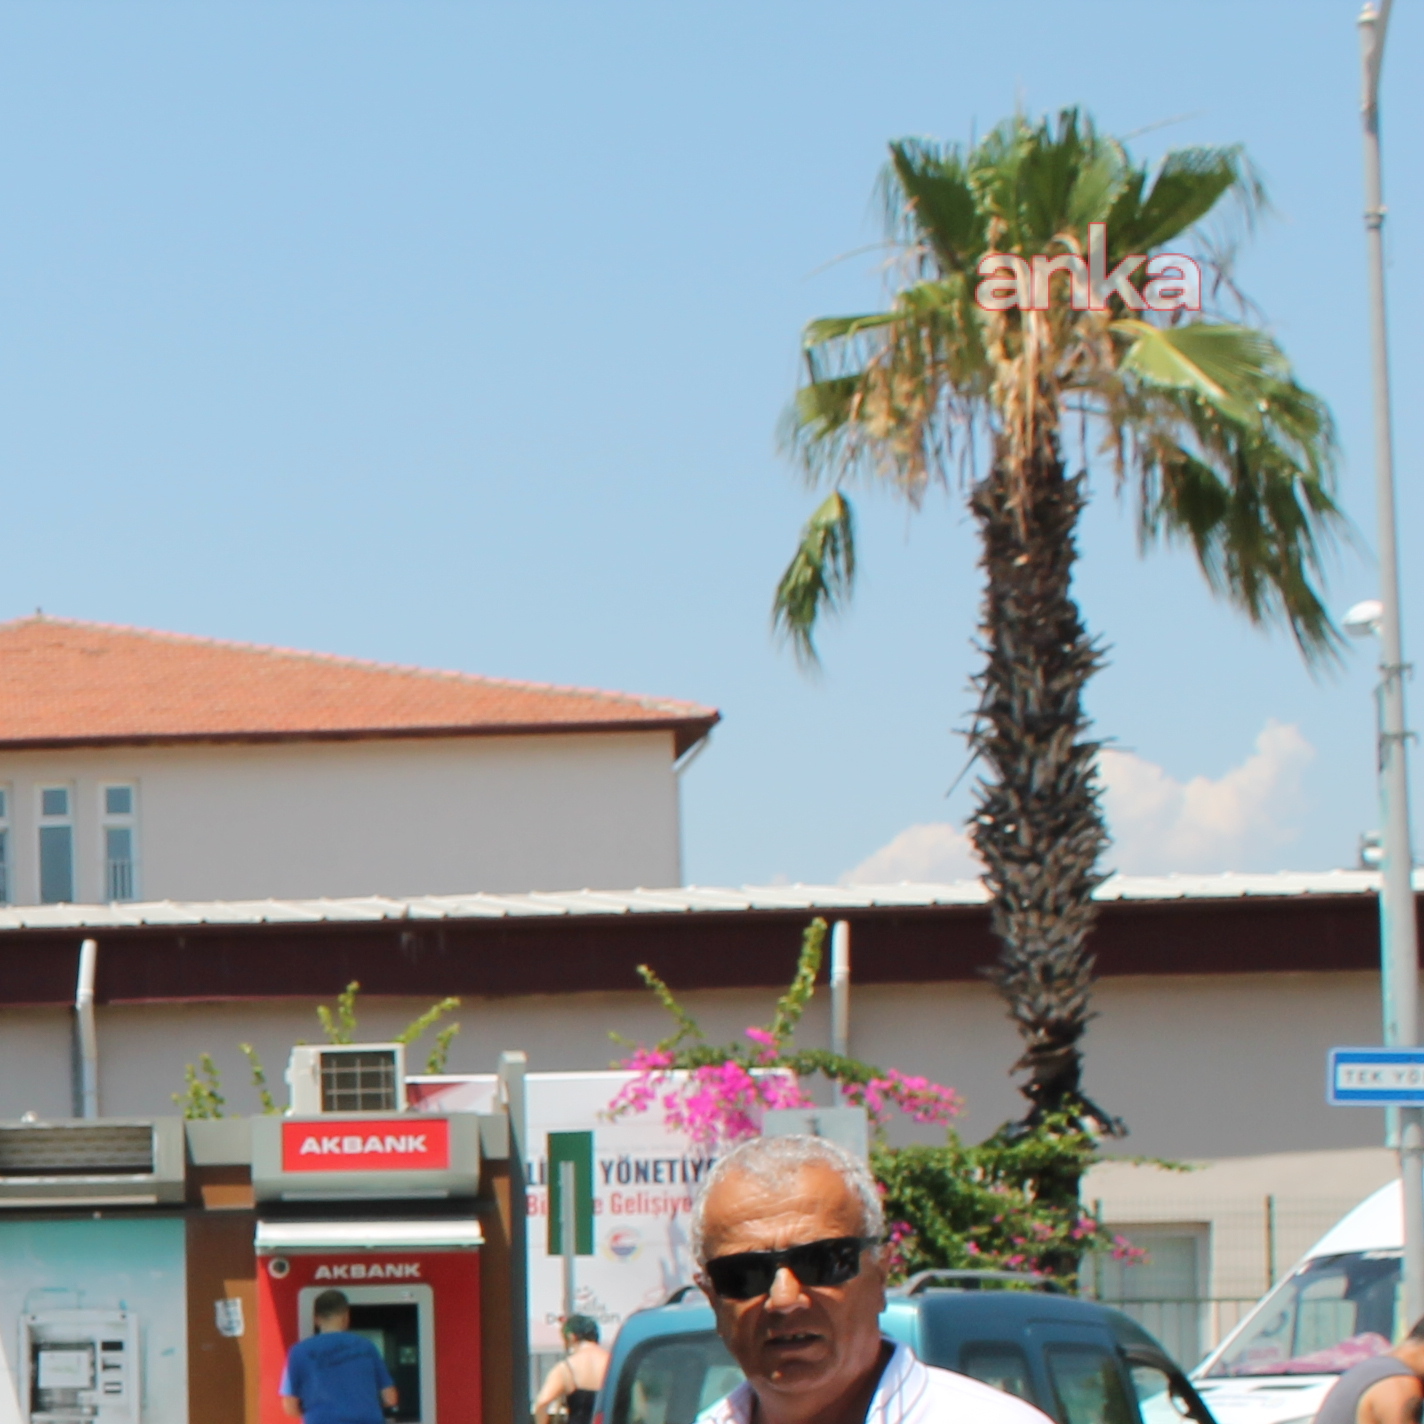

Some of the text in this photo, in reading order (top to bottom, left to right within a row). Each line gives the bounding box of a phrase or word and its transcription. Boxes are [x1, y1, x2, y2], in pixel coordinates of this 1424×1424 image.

[1345, 1068, 1424, 1084] TEK YÖ
[299, 1134, 428, 1155] AKBANK
[314, 1263, 421, 1280] AKBANK
